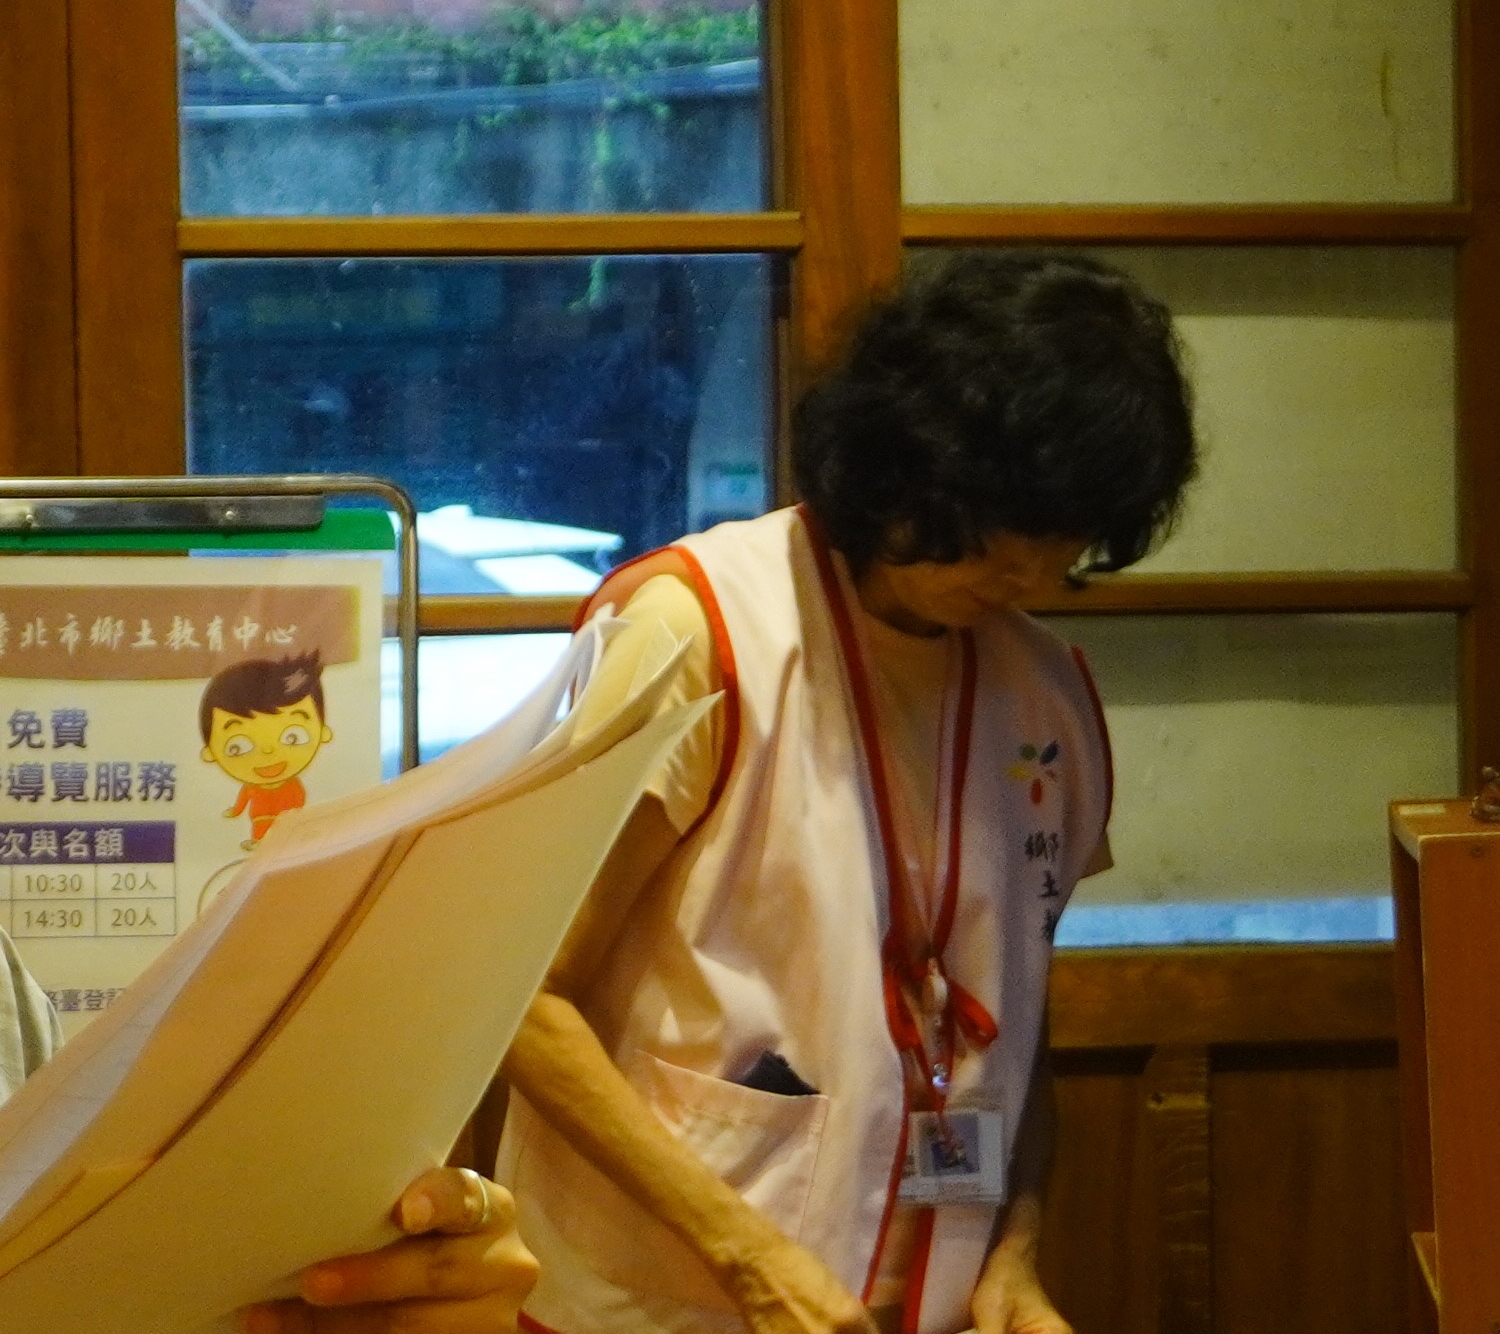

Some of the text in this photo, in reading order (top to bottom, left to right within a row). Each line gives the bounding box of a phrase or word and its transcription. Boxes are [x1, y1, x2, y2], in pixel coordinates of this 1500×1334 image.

[24, 873, 83, 893] 10:30
[111, 872, 158, 893] 20人
[24, 907, 158, 929] 14:30 20人
